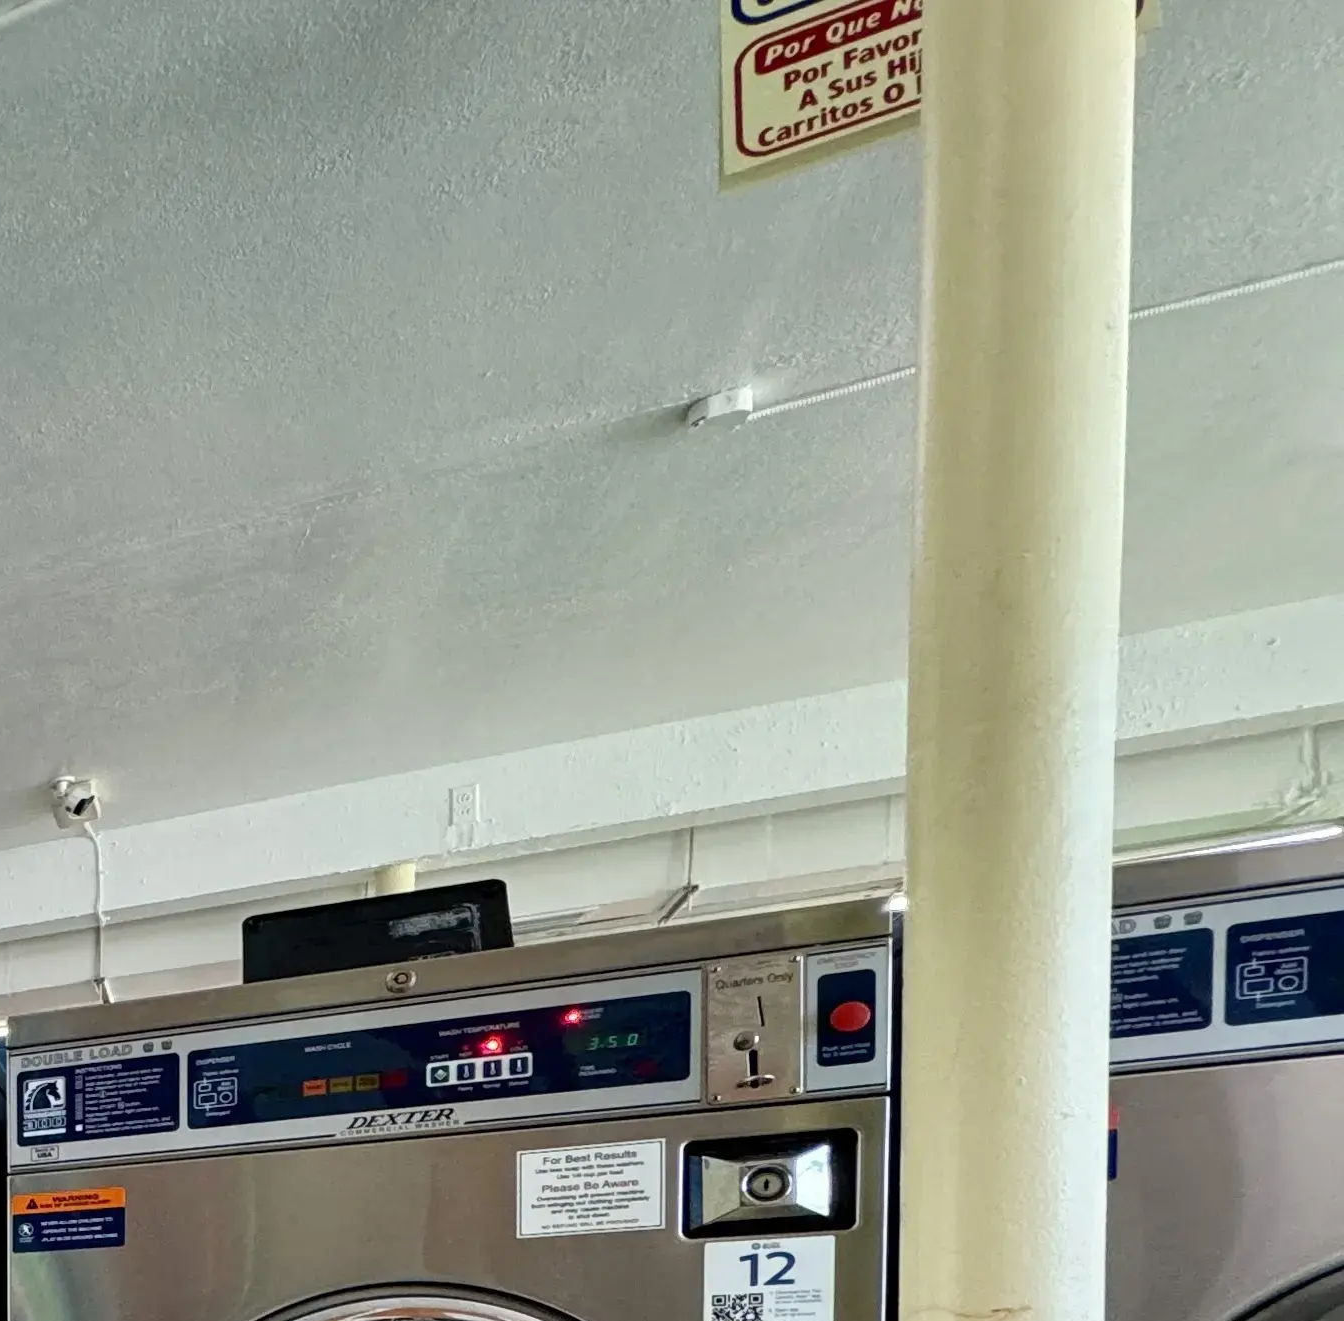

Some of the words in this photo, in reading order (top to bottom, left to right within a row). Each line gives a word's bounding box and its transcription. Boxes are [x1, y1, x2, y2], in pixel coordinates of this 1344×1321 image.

[764, 33, 815, 67] Por
[826, 11, 881, 44] Que
[783, 61, 833, 92] Por
[843, 29, 922, 69] Favor
[798, 89, 818, 112] A
[828, 70, 877, 100] Sus
[758, 96, 874, 147] Carritos
[883, 83, 905, 104] O
[715, 975, 763, 991] Quarters
[767, 972, 794, 983] Only
[439, 1028, 462, 1037] WASH
[463, 1021, 521, 1034] TEMPERATURE
[21, 1050, 84, 1069] DOUBLE
[89, 1044, 133, 1060] LOAD
[304, 1045, 326, 1053] WASH
[327, 1041, 352, 1050] CYCLE
[339, 1124, 410, 1137] COMMERCIAL
[415, 1119, 460, 1129] WASHER
[346, 1108, 455, 1130] DEXTER
[543, 1157, 562, 1165] For
[565, 1153, 591, 1163] Best
[594, 1150, 637, 1161] Results
[541, 1184, 580, 1193] Please
[583, 1181, 599, 1190] Be
[602, 1179, 639, 1188] Aware
[739, 1251, 796, 1286] 12
